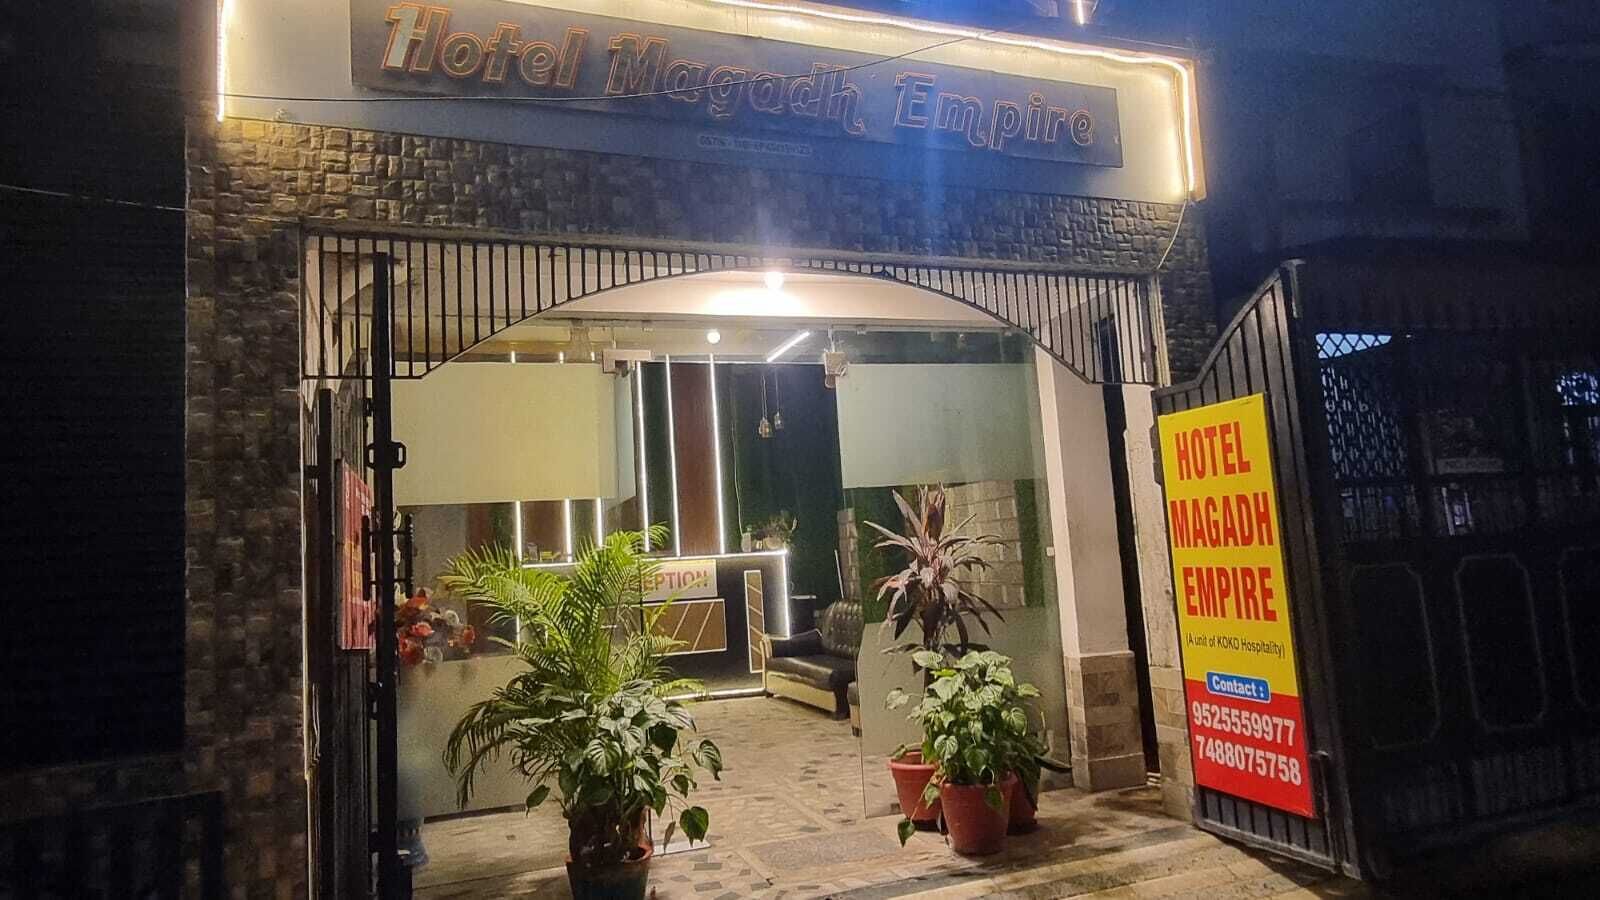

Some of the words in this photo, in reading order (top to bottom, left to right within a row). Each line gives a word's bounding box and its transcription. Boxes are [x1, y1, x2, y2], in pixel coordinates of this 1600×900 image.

[381, 3, 589, 90] Hotel
[605, 33, 864, 137] Magadh
[894, 71, 1096, 151] Empire
[1175, 421, 1251, 481] HOTEL
[1170, 491, 1274, 548] MAGADH
[1182, 566, 1277, 622] EMPIRE
[1186, 633, 1194, 648] (A
[1195, 635, 1207, 647] unit
[1209, 636, 1217, 648] of
[1217, 636, 1240, 650] KOKO
[1241, 638, 1286, 659] Hospitality)
[1212, 675, 1258, 697] Contact
[1192, 701, 1296, 747] 9525559977
[1195, 735, 1302, 786] 7488075758
